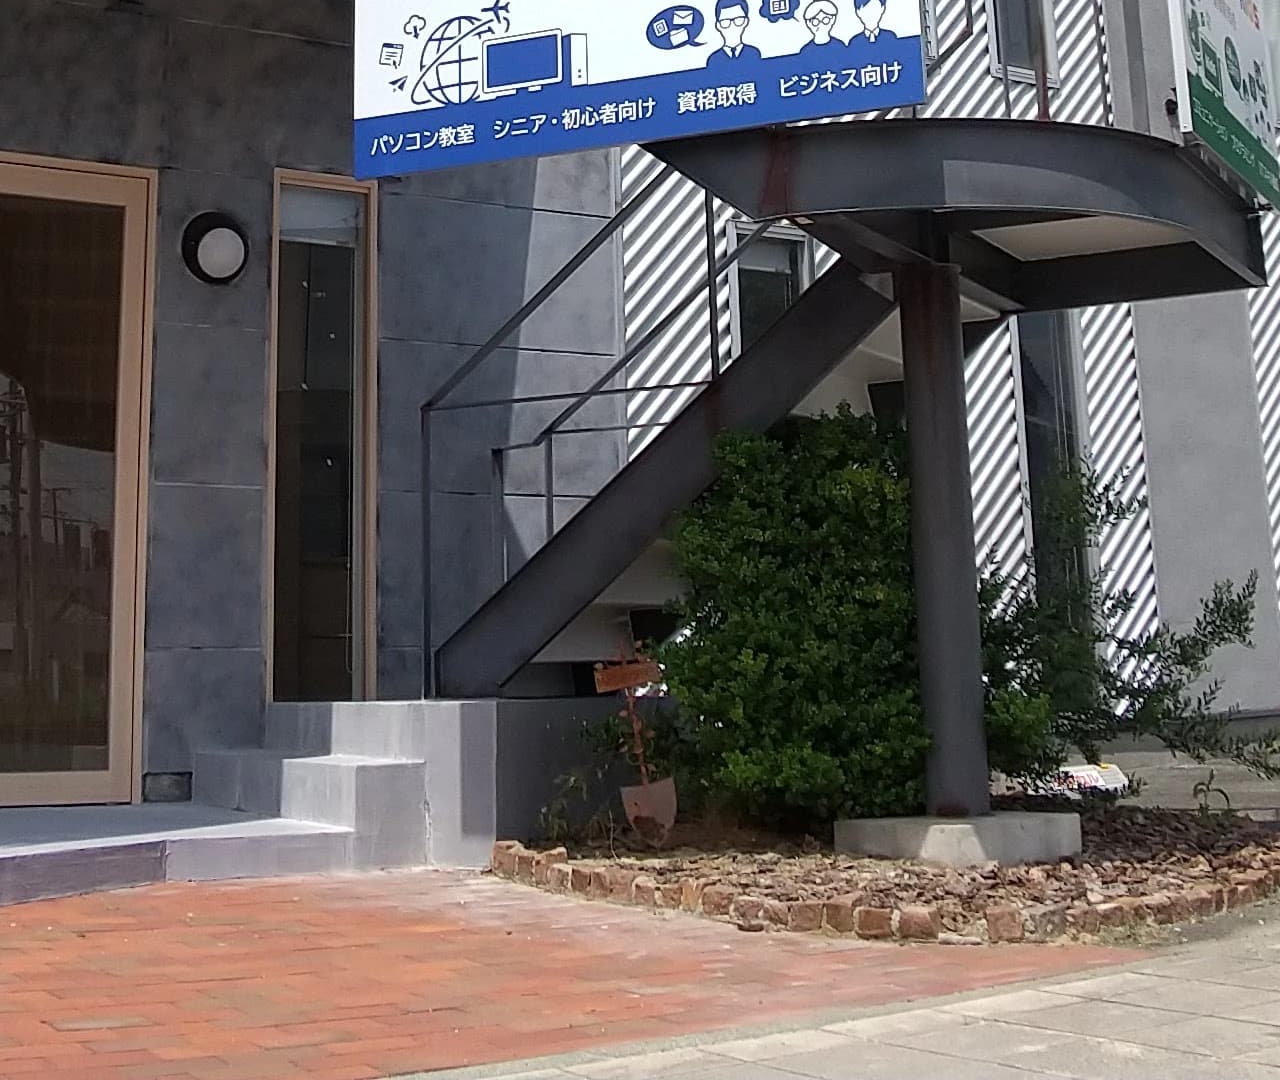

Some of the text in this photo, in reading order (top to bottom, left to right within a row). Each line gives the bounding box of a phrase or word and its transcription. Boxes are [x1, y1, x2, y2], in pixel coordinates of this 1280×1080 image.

[370, 61, 902, 156] パソコン教室 シニア・初心者向け 資格取得 ビジネス向け
